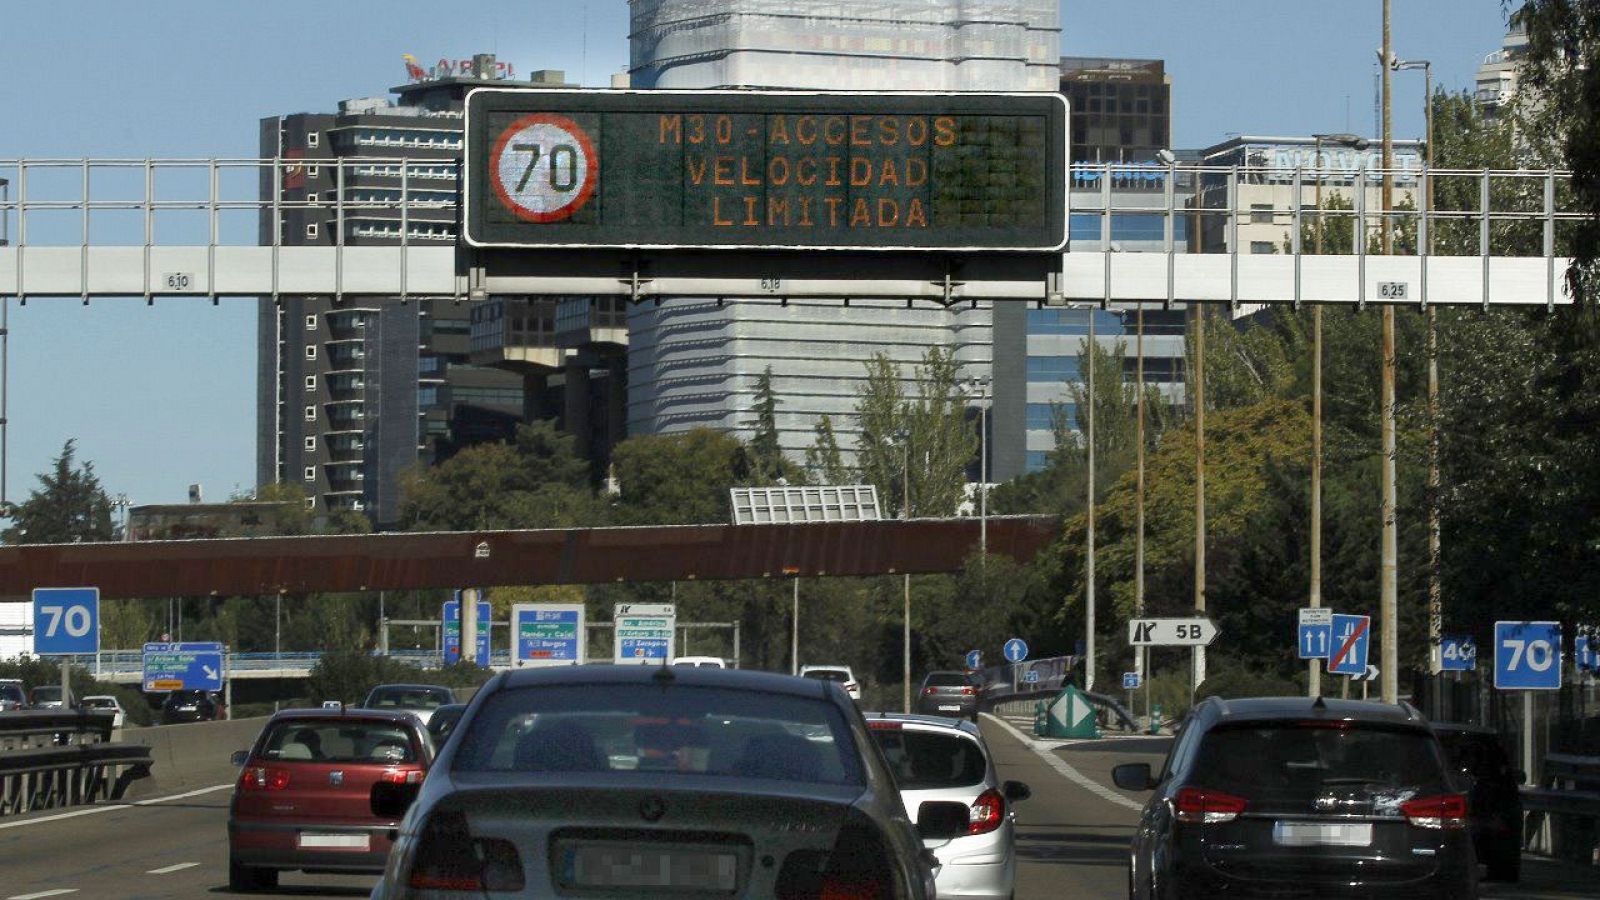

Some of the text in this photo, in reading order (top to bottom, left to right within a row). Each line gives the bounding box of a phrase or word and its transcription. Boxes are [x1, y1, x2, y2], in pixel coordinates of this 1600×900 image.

[512, 143, 577, 193] 70
[686, 155, 928, 186] VELOCIDAD
[713, 197, 927, 227] LIMITADA
[41, 605, 91, 637] 70
[1176, 624, 1202, 639] 5B
[1503, 639, 1553, 672] 70
